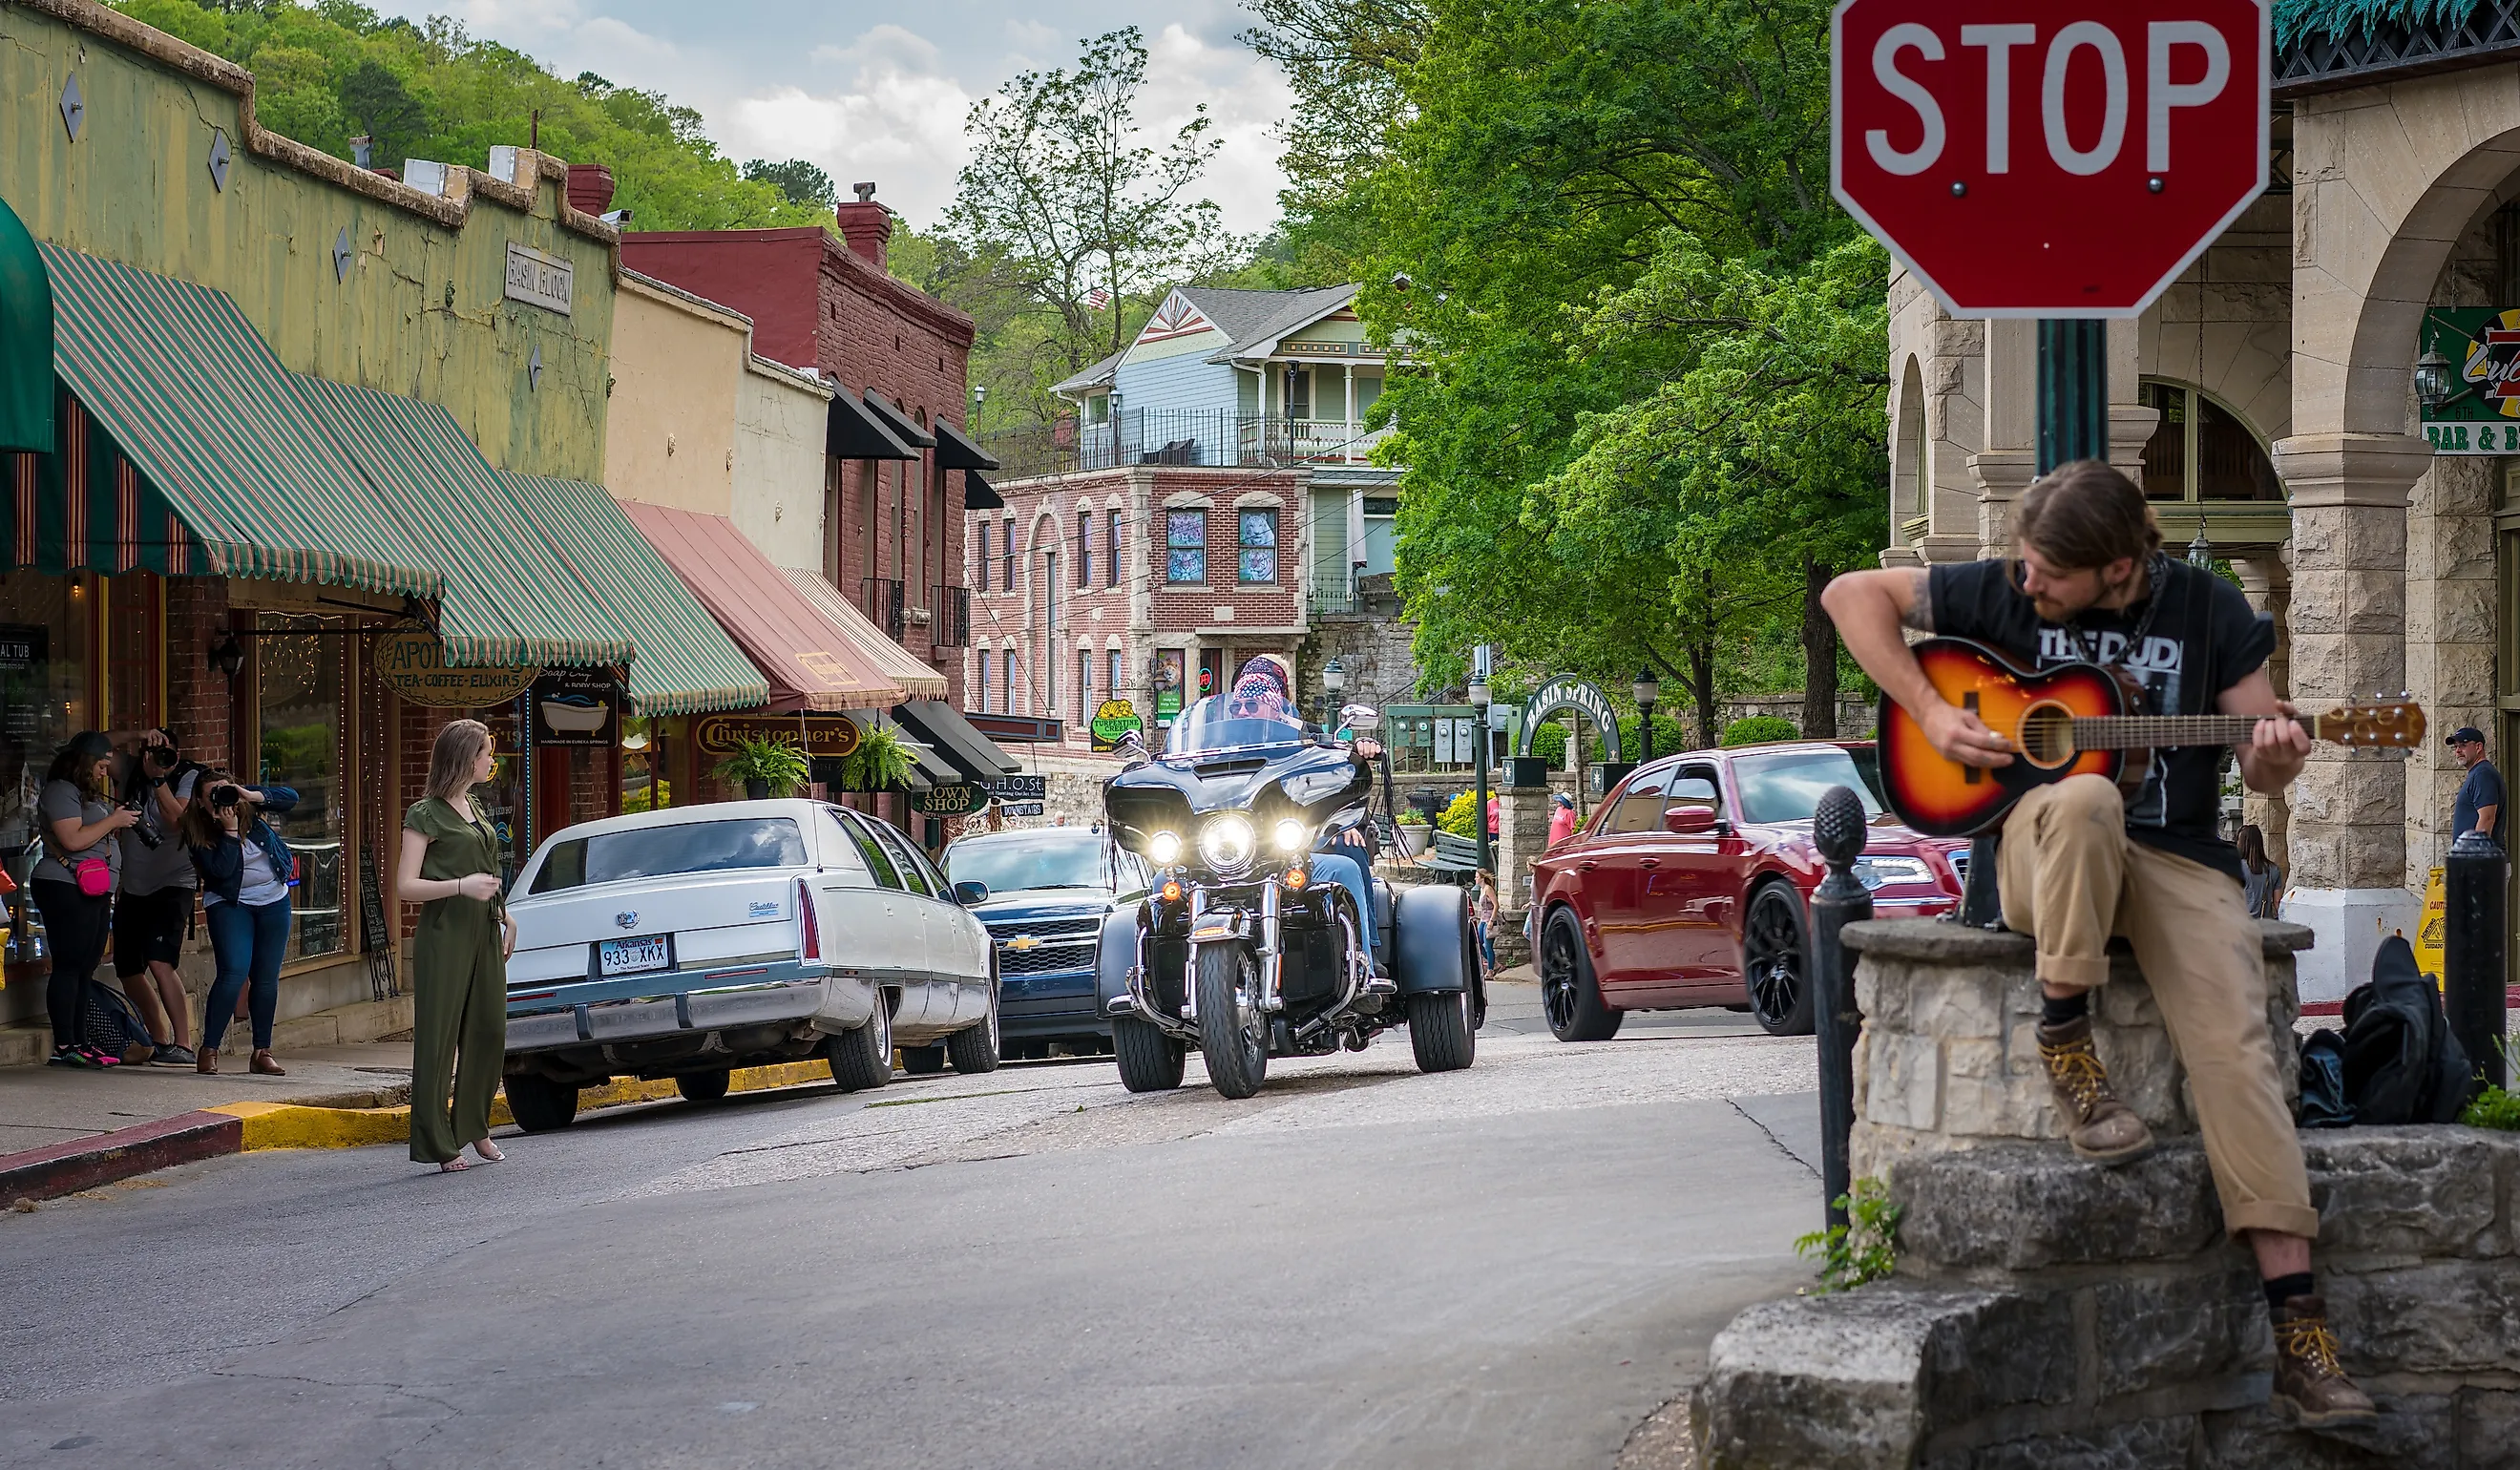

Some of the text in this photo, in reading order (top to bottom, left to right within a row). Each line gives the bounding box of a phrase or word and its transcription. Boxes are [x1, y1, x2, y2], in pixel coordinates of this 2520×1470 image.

[1865, 20, 2231, 176] STOP
[508, 256, 571, 305] BASIN BLOCK
[2426, 426, 2469, 452] BAR
[2478, 426, 2496, 452] &
[13, 644, 30, 658] TUB
[2099, 630, 2184, 670] DUD
[537, 667, 566, 682] Soap
[1527, 682, 1563, 733] BASIN
[706, 723, 850, 748] Christopher's
[924, 798, 969, 810] SHOP
[2421, 917, 2437, 939] ACHTUNG
[616, 938, 652, 950] Arkansas
[603, 945, 664, 967] 933 XKX
